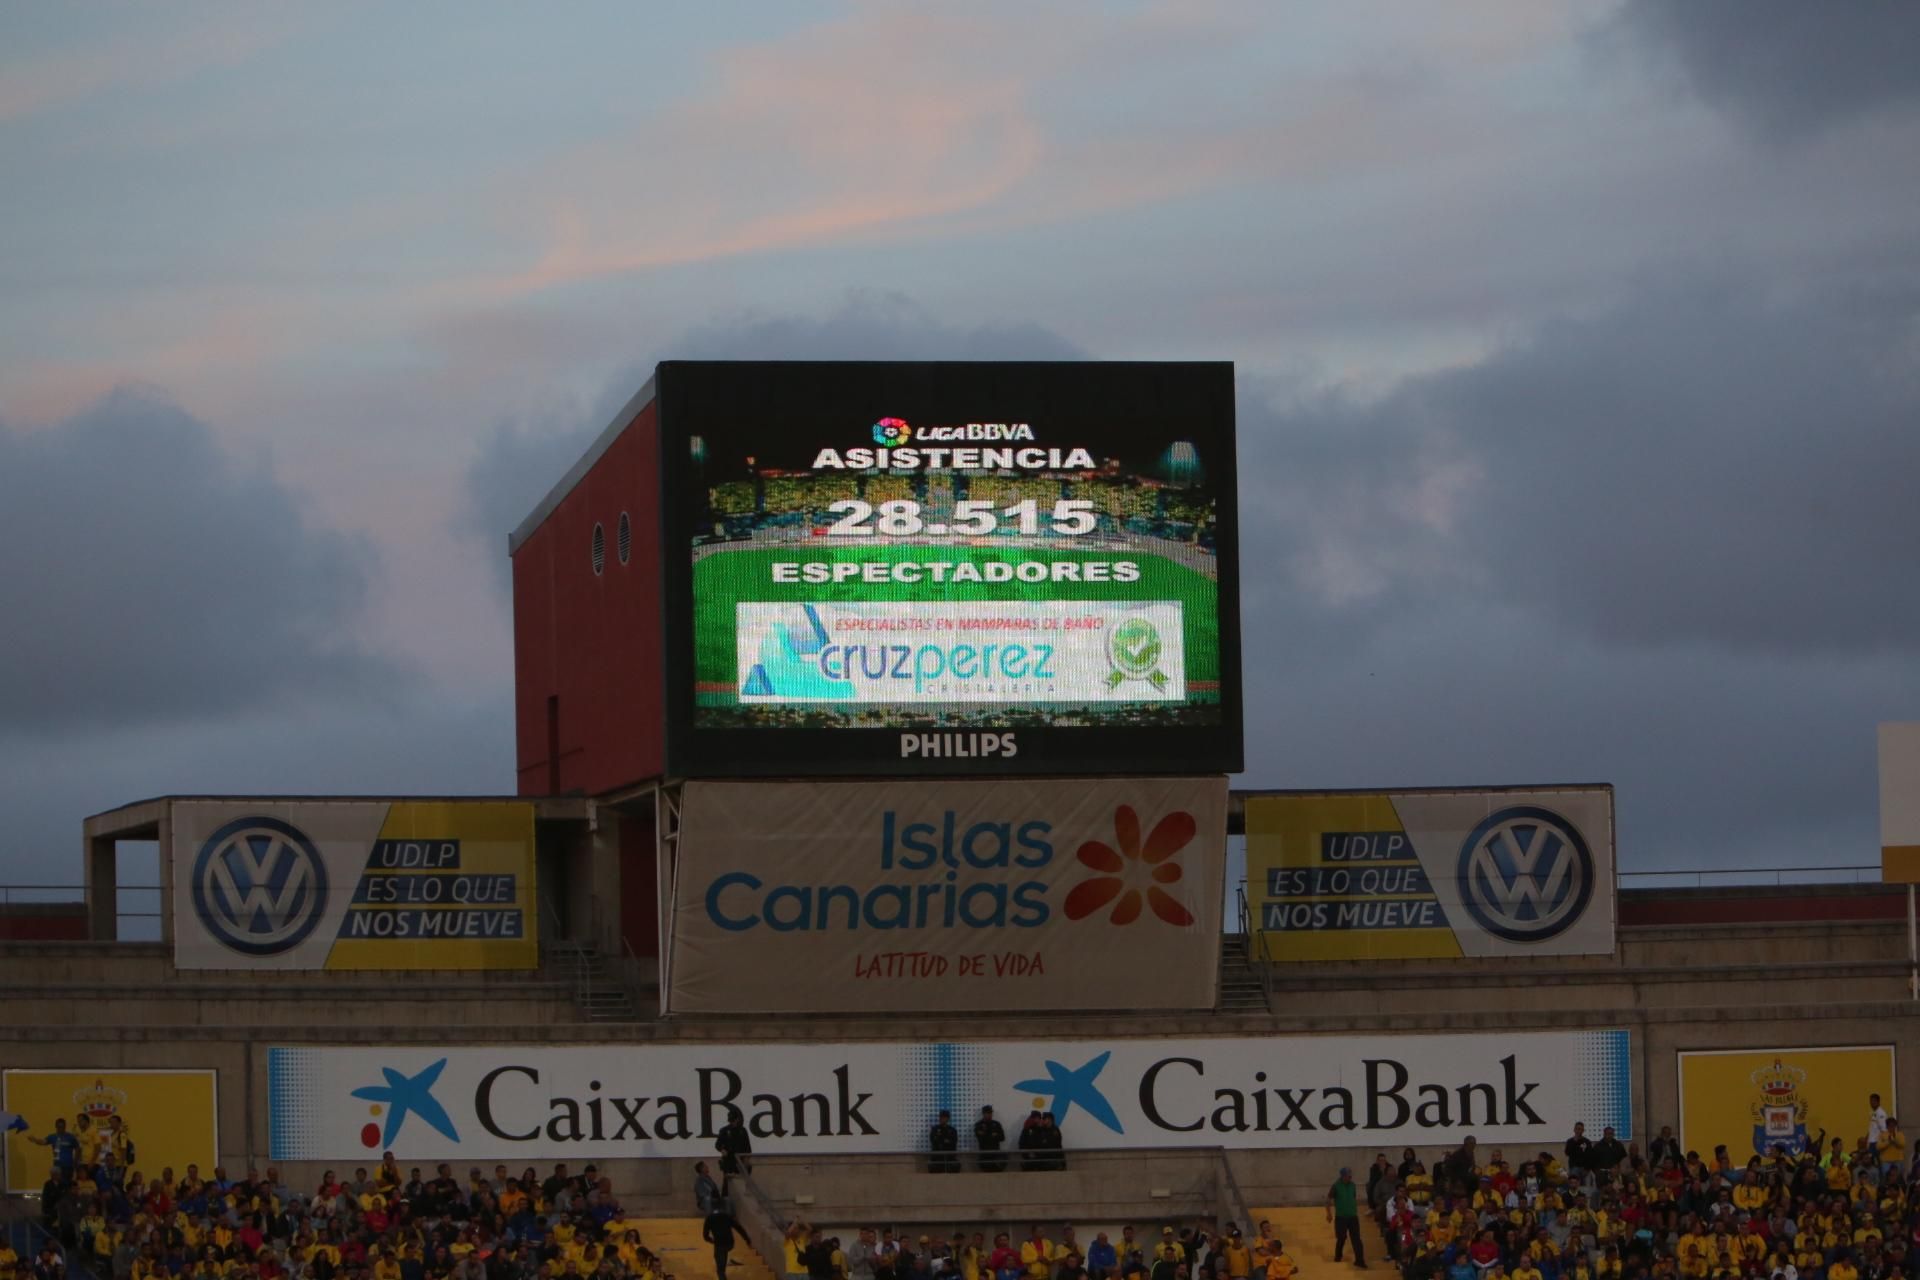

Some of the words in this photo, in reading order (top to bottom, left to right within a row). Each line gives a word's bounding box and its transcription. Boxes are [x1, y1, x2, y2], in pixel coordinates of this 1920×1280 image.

[812, 448, 1096, 469] ASISTENCIA
[826, 499, 1097, 536] 28.515
[772, 561, 1141, 583] ESPECTADORES
[835, 618, 931, 631] ESPECIALISTAS
[936, 618, 953, 631] EN
[958, 618, 1038, 631] MAMPARAS
[1042, 618, 1060, 631] DE
[900, 733, 1018, 758] PHILIPS
[881, 810, 1053, 870] Islas
[1330, 834, 1404, 860] UDLP
[382, 843, 455, 867] UDLP
[367, 877, 399, 901] ES
[407, 877, 442, 902] LO
[452, 877, 511, 904] QUE
[1274, 870, 1307, 895] ES
[1315, 869, 1350, 894] LO
[1360, 868, 1420, 896] QUE
[705, 871, 1051, 932] Canarias
[1268, 904, 1328, 929] NOS
[1336, 901, 1439, 926] MUEVE
[351, 911, 410, 936] NOS
[418, 911, 518, 936] MUEVE
[855, 951, 948, 979] LATITUD
[959, 953, 987, 977] DE
[993, 951, 1045, 978] VIDA
[475, 1063, 880, 1142] CaixaBank
[1138, 1054, 1547, 1133] CaixaBank
